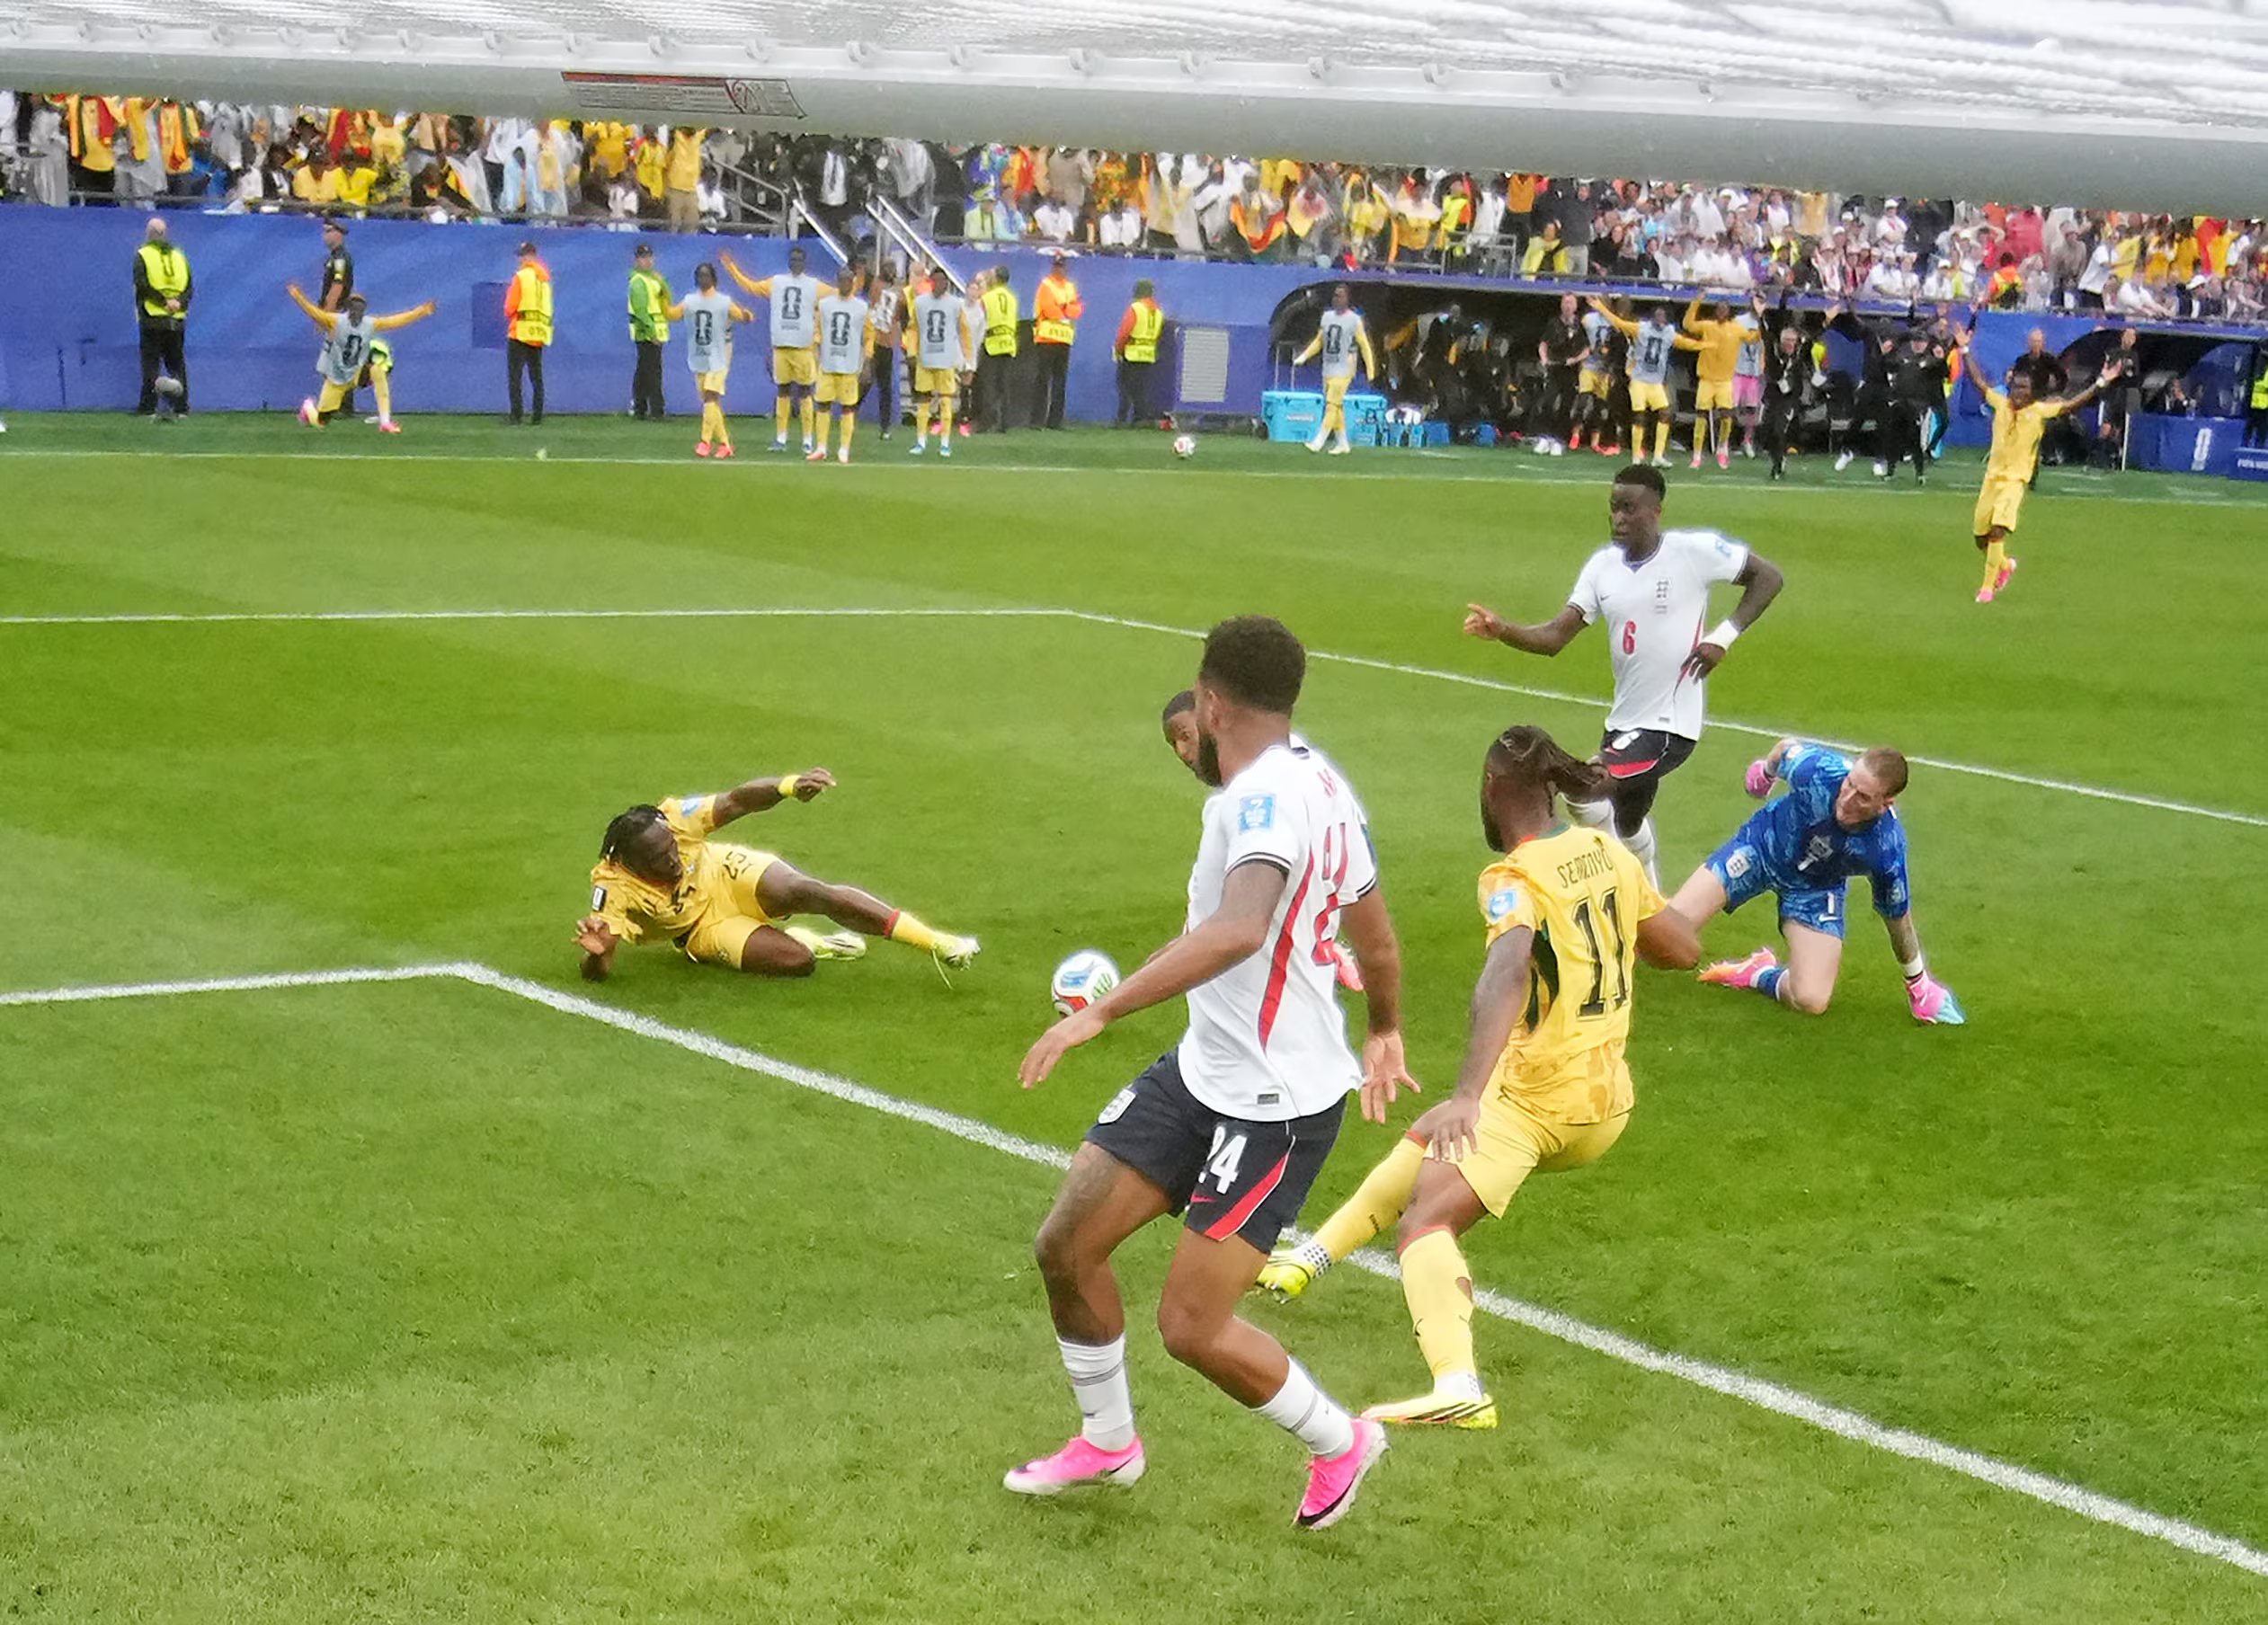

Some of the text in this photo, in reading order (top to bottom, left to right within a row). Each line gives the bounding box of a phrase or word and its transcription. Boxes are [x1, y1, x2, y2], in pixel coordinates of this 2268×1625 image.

[1623, 620, 1637, 655] 6
[1827, 891, 1836, 914] 1
[1572, 886, 1630, 1022] 11
[1198, 1125, 1248, 1194] 24
